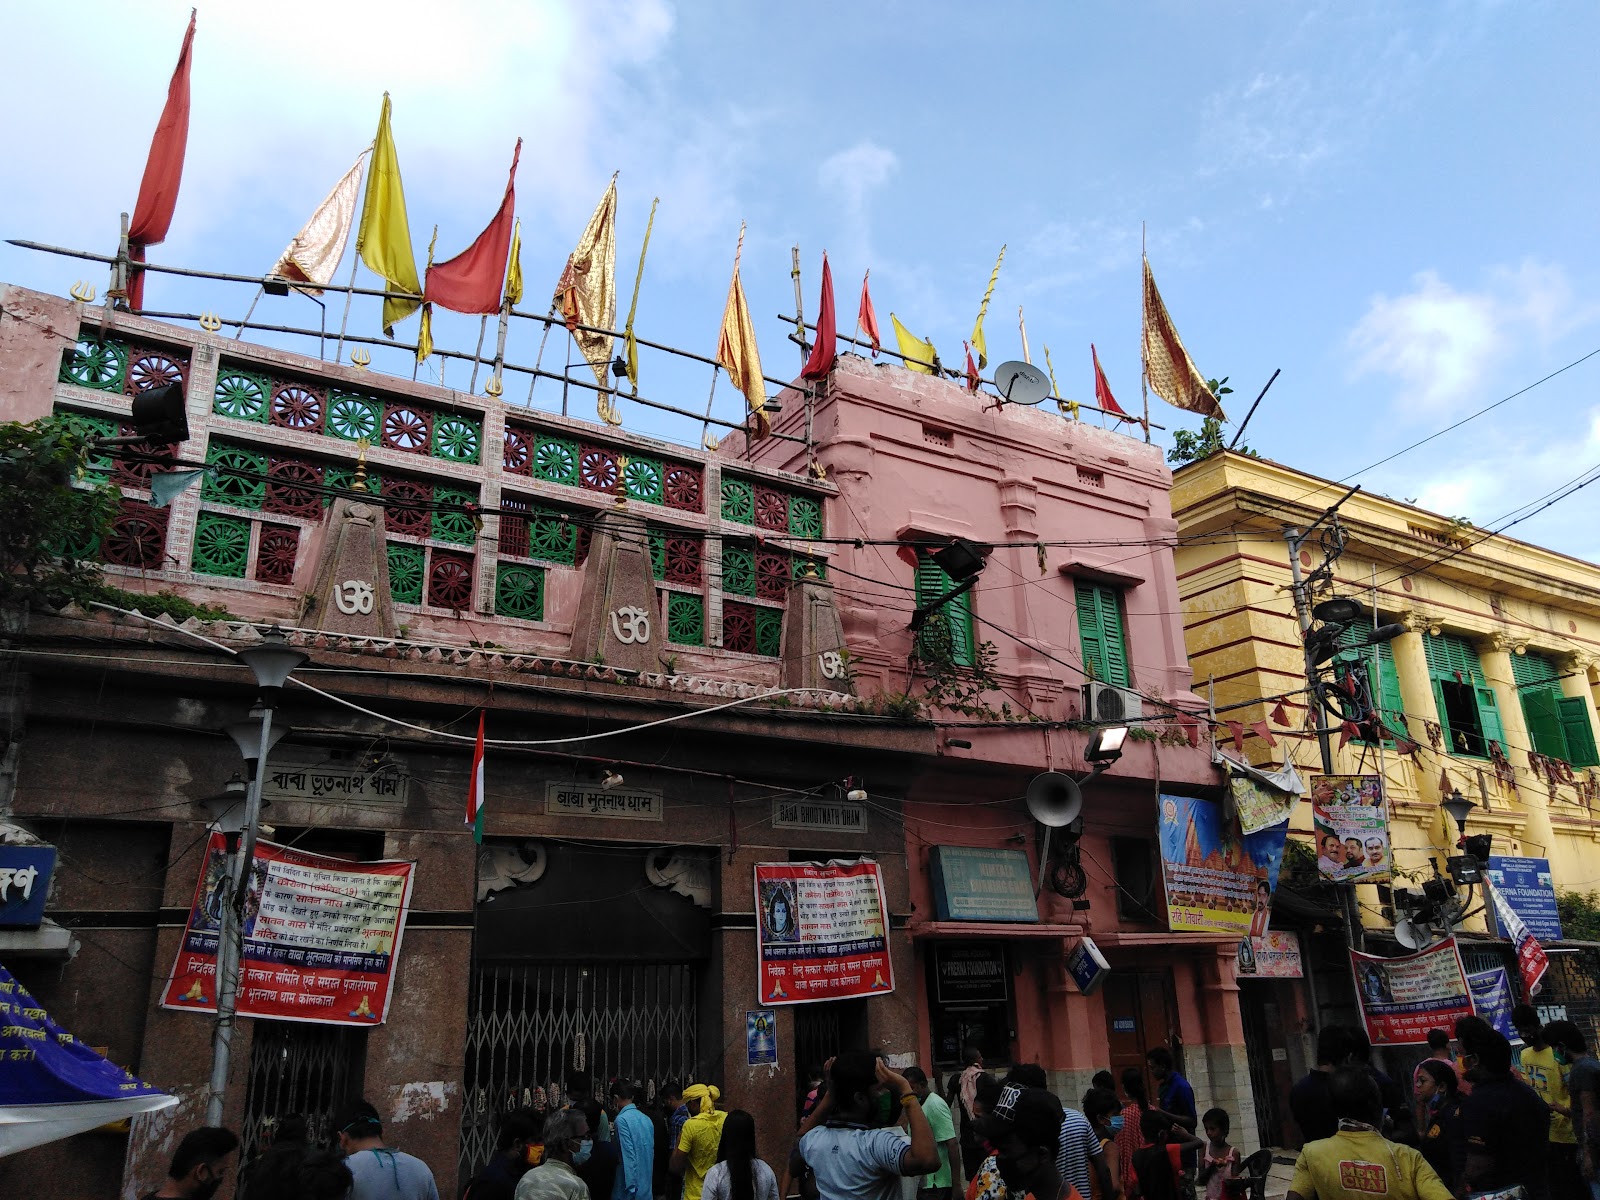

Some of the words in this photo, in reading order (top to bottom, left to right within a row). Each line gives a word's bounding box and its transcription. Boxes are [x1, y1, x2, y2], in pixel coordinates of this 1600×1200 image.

[272, 772, 306, 790] বাবা
[311, 774, 365, 796] ভূতনাথ
[370, 775, 396, 795] ধাম
[557, 791, 584, 808] बाबा
[588, 793, 625, 812] भूतनाथ
[628, 796, 652, 812] धाम
[780, 805, 798, 822] BABA
[801, 806, 840, 825] BHOOTNATH
[842, 809, 860, 826] DHAM
[1518, 888, 1553, 897] FOUNDATION
[1342, 1166, 1383, 1180] MERI
[1343, 1176, 1385, 1191] CHAI
